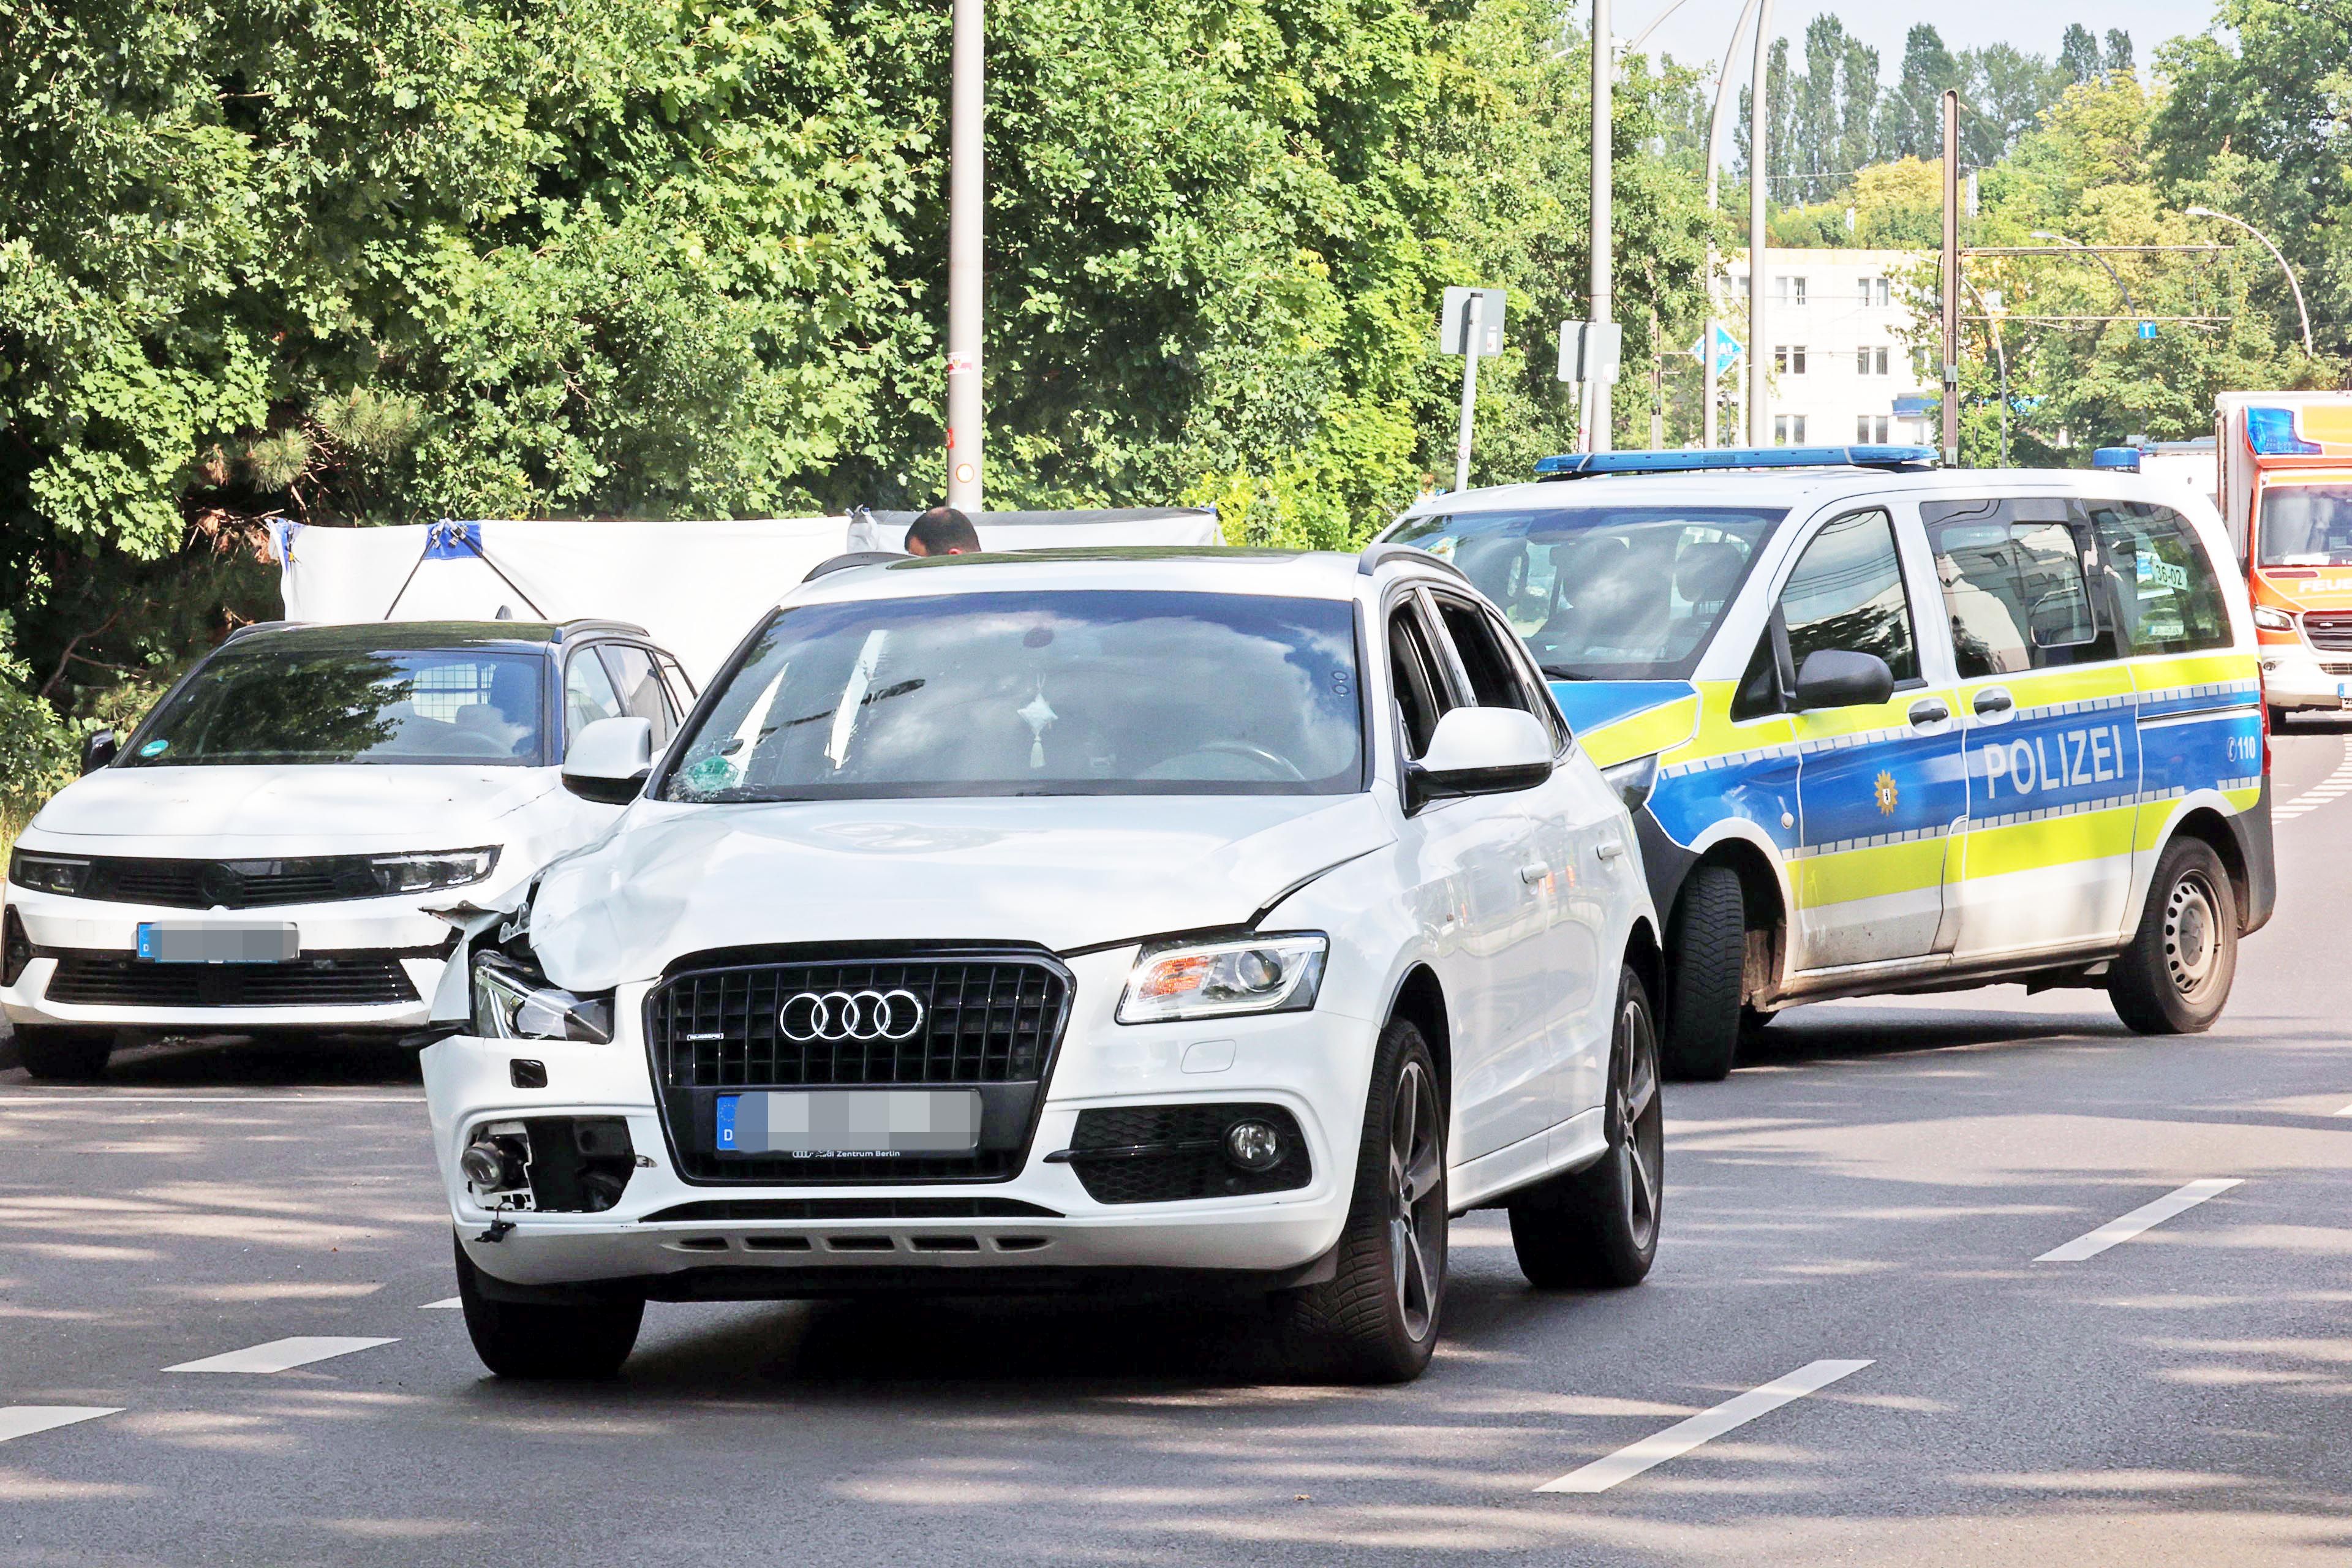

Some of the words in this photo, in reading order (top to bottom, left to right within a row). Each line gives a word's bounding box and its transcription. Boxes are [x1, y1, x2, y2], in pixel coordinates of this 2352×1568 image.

[2155, 565, 2182, 586] 36-02
[2237, 736, 2256, 760] 110
[1983, 725, 2124, 799] POLIZEI
[723, 1129, 733, 1141] D
